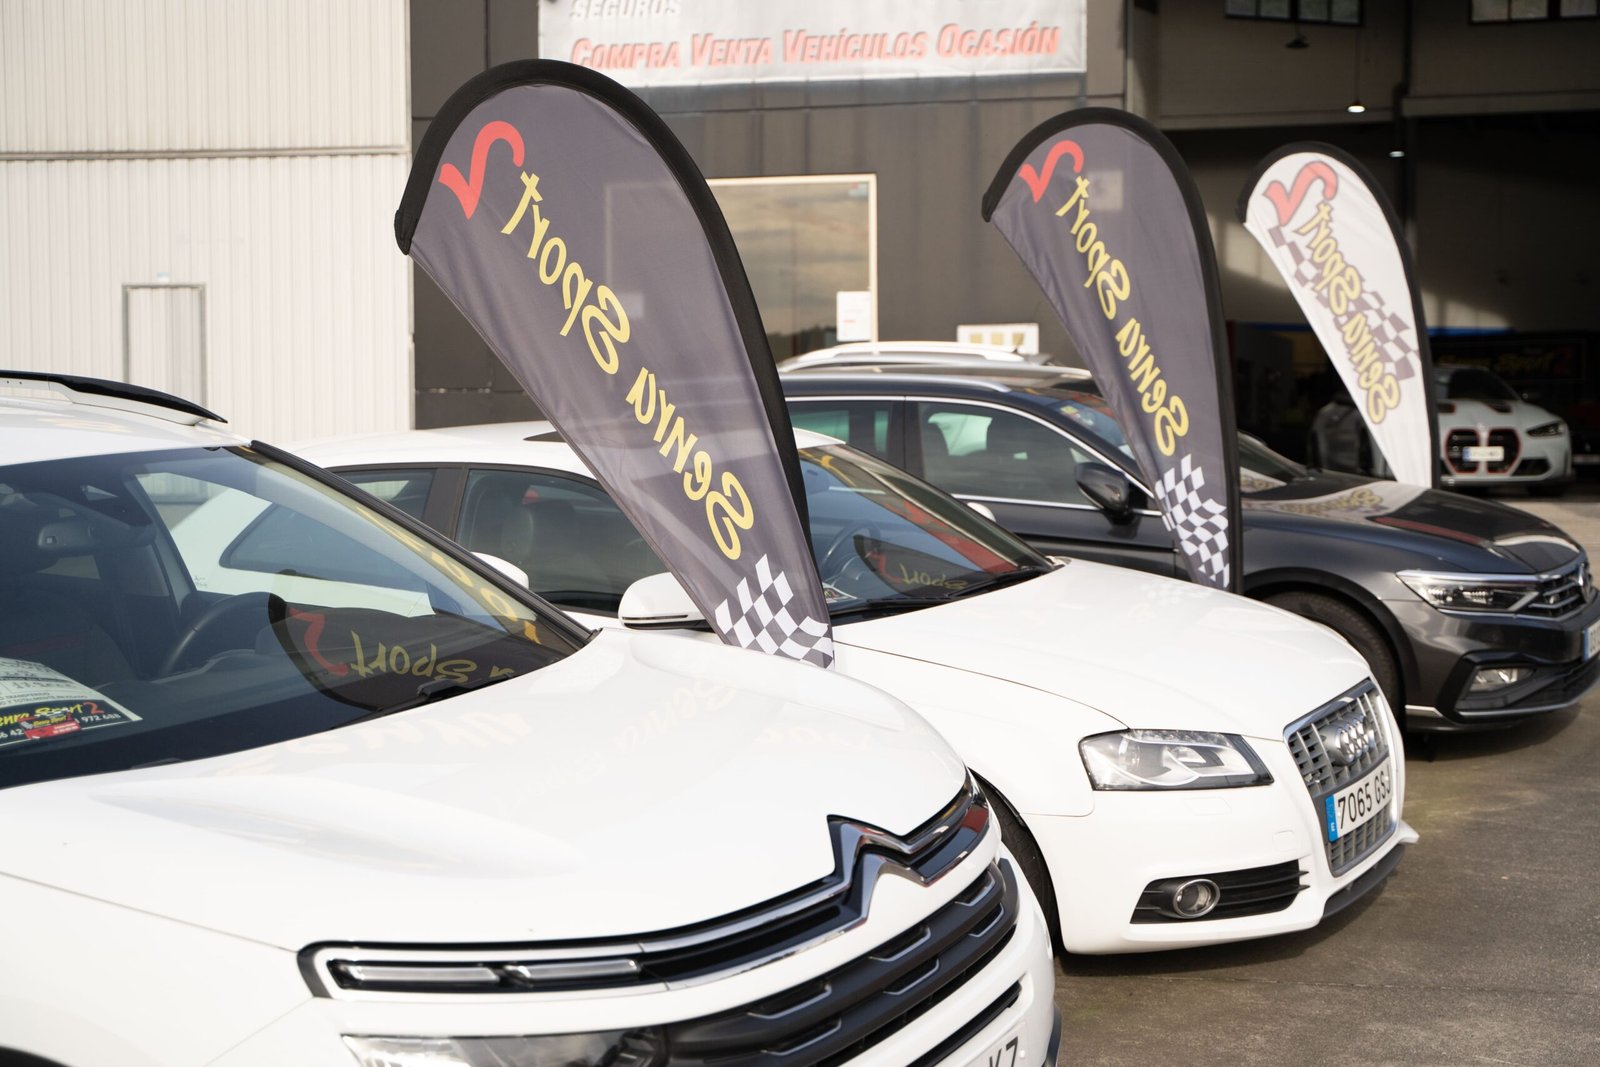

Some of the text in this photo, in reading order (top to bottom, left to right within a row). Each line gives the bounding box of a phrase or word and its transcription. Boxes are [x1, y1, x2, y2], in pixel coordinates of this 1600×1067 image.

[569, 0, 681, 20] SEGUROS
[571, 21, 1061, 70] COMPRA VENTA VEHÍCULOS OCASIÓN
[1337, 782, 1372, 830] 7065
